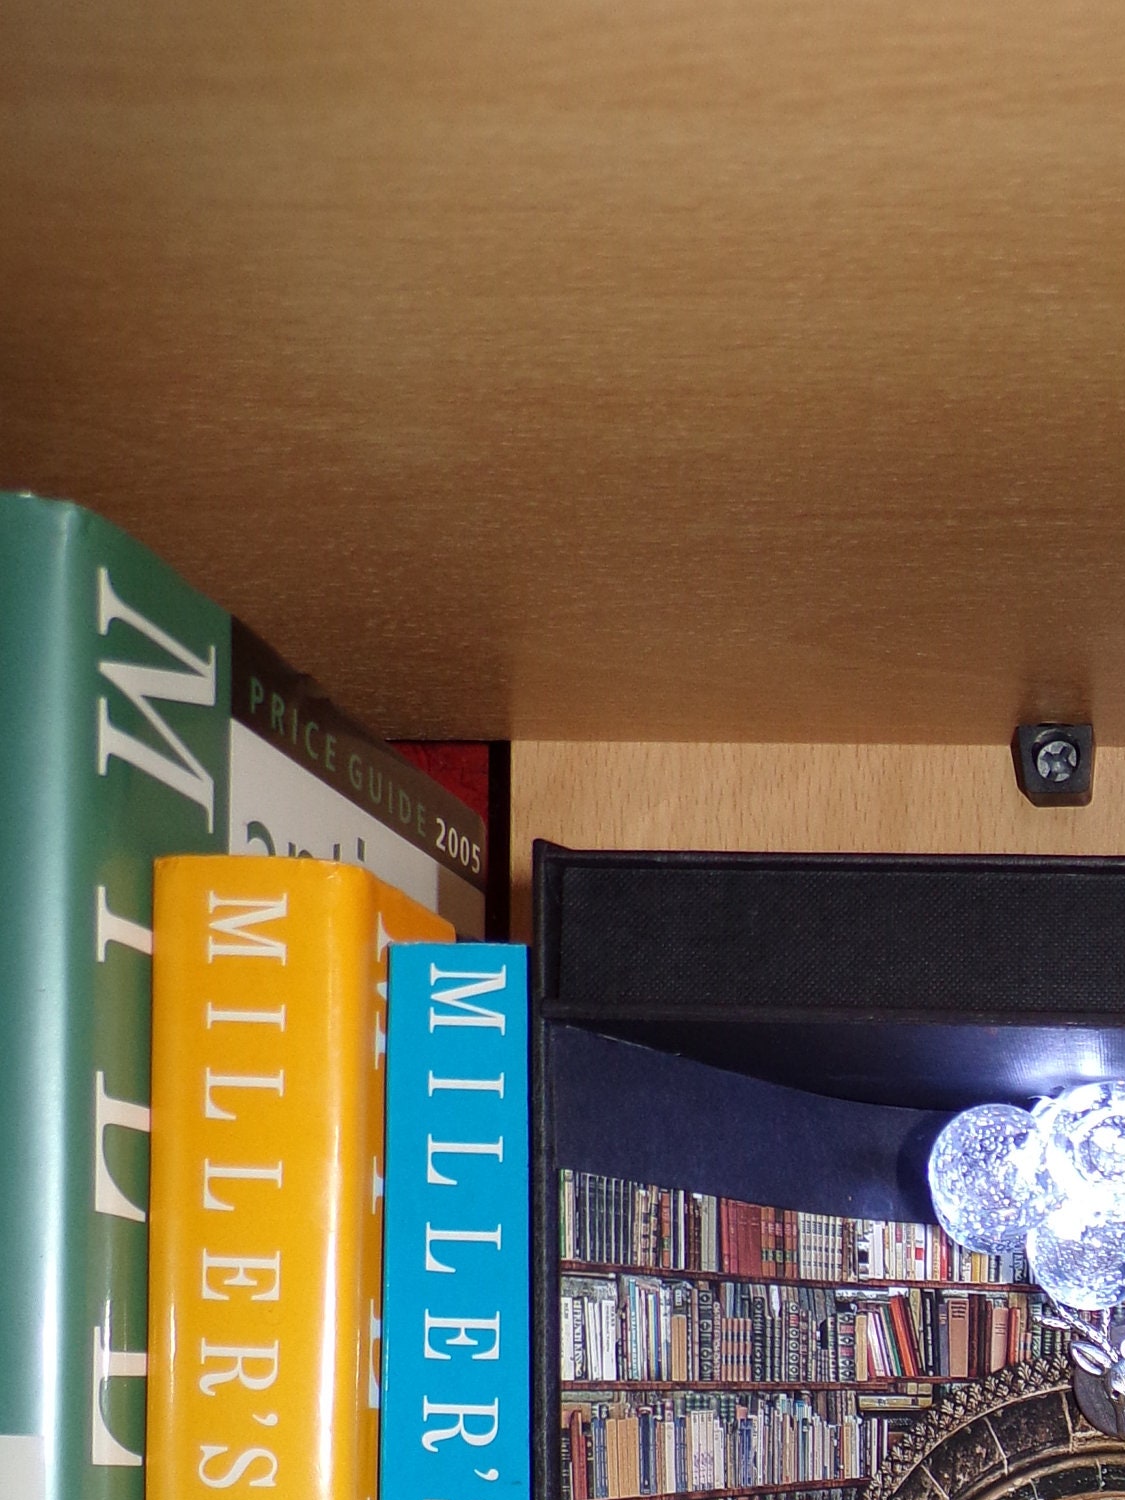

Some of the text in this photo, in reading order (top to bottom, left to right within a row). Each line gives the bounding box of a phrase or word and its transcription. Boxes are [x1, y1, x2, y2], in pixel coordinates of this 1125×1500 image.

[249, 676, 337, 772] PRICE
[347, 754, 427, 837] GUIDE
[435, 817, 481, 874] 2005
[198, 890, 289, 1489] MILLER'S
